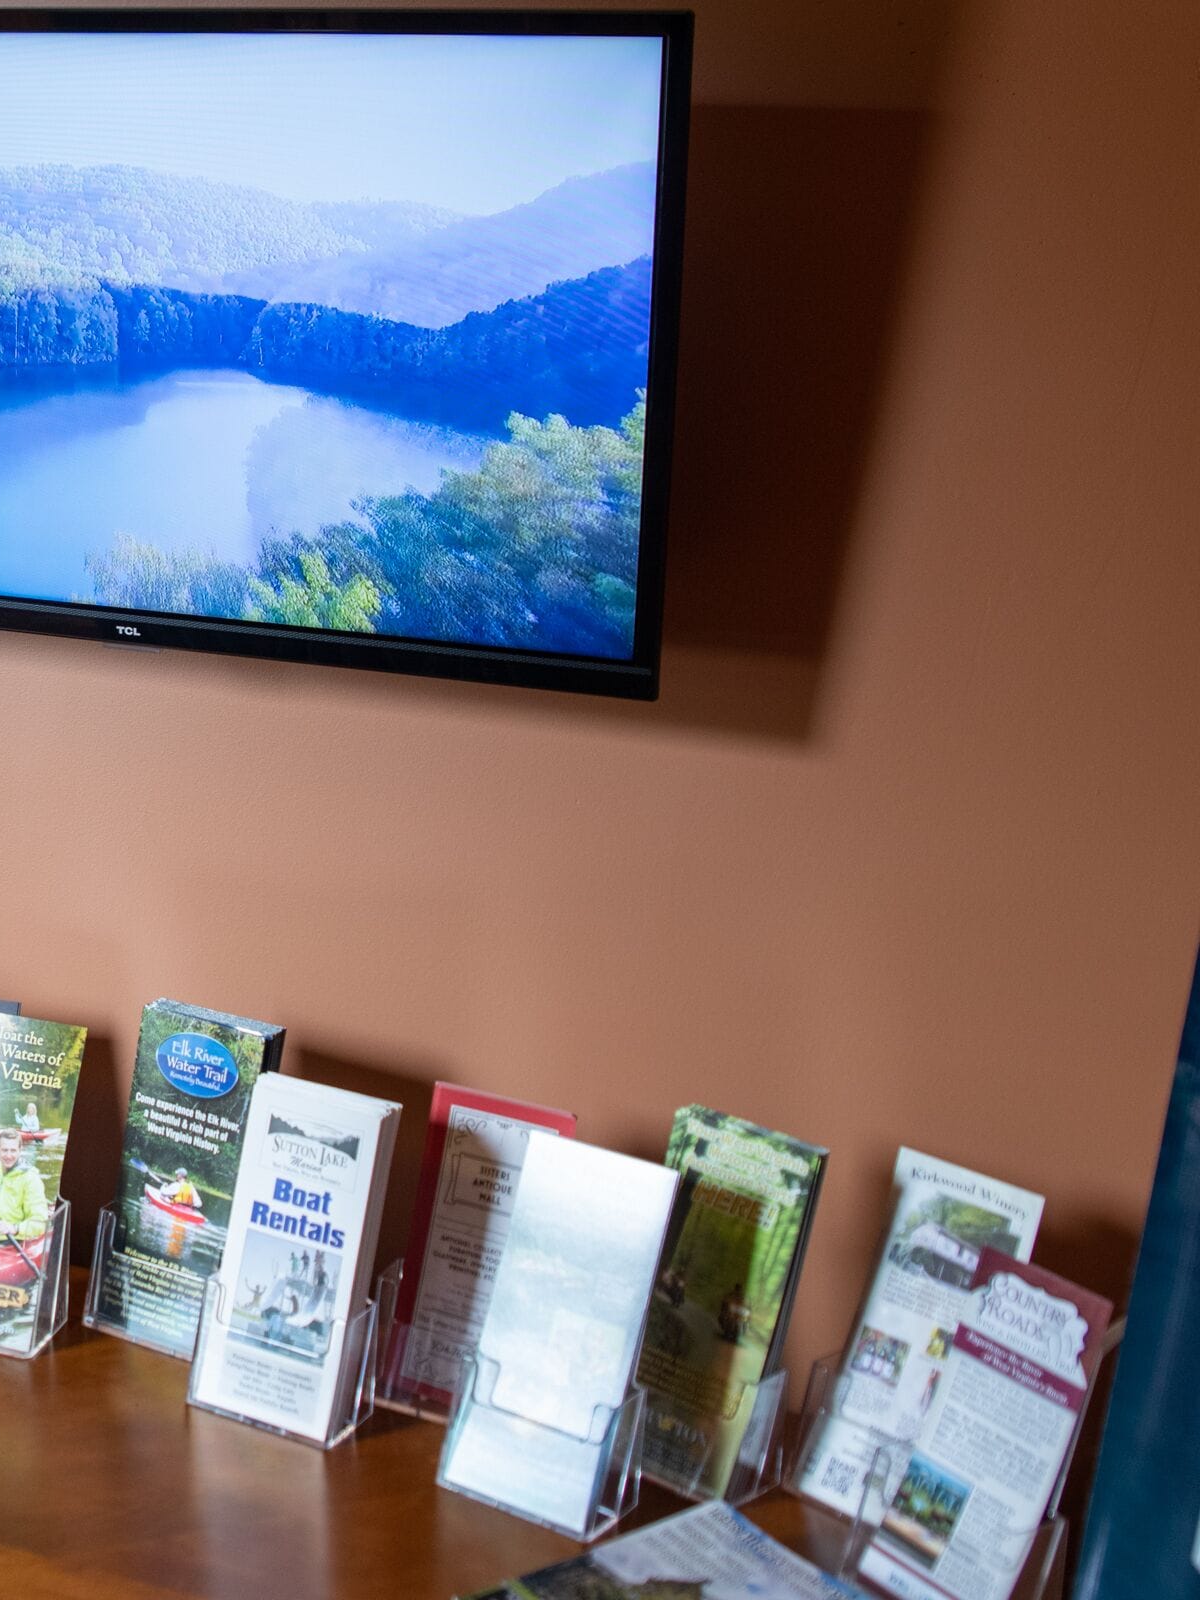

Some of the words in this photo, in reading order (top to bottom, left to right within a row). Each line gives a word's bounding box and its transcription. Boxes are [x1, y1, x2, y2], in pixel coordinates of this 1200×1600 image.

[116, 625, 141, 636] TCL
[1, 1043, 46, 1064] Waters
[48, 1052, 66, 1067] of
[24, 1031, 44, 1047] the
[172, 1039, 192, 1057] Elk
[194, 1047, 224, 1066] River
[0, 1062, 62, 1090] Virginia
[166, 1054, 201, 1075] Water
[203, 1065, 228, 1084] Trail
[135, 1091, 155, 1106] Come
[156, 1098, 195, 1118] experience
[195, 1108, 207, 1121] the
[207, 1113, 220, 1125] Elk
[220, 1116, 240, 1134] River,
[143, 1108, 149, 1117] a
[150, 1109, 181, 1129] beautiful
[181, 1118, 188, 1128] &
[189, 1121, 204, 1135] rich
[204, 1127, 220, 1141] part
[221, 1131, 229, 1142] of
[147, 1121, 164, 1136] West
[165, 1126, 193, 1145] Virginia
[193, 1135, 220, 1155] History.
[272, 1134, 319, 1163] SUTTON
[320, 1147, 348, 1168] LAKE
[472, 1178, 513, 1195] ANTIQUE
[480, 1165, 511, 1181] SISTERS
[273, 1177, 333, 1216] Boat
[479, 1192, 502, 1206] MALL
[690, 1179, 780, 1228] HERE!
[911, 1167, 977, 1196] Kirkwood
[981, 1188, 1029, 1221] Winery
[250, 1200, 346, 1250] Rentals
[987, 1296, 1043, 1341] ROADS
[993, 1277, 1067, 1327] COUNTRY
